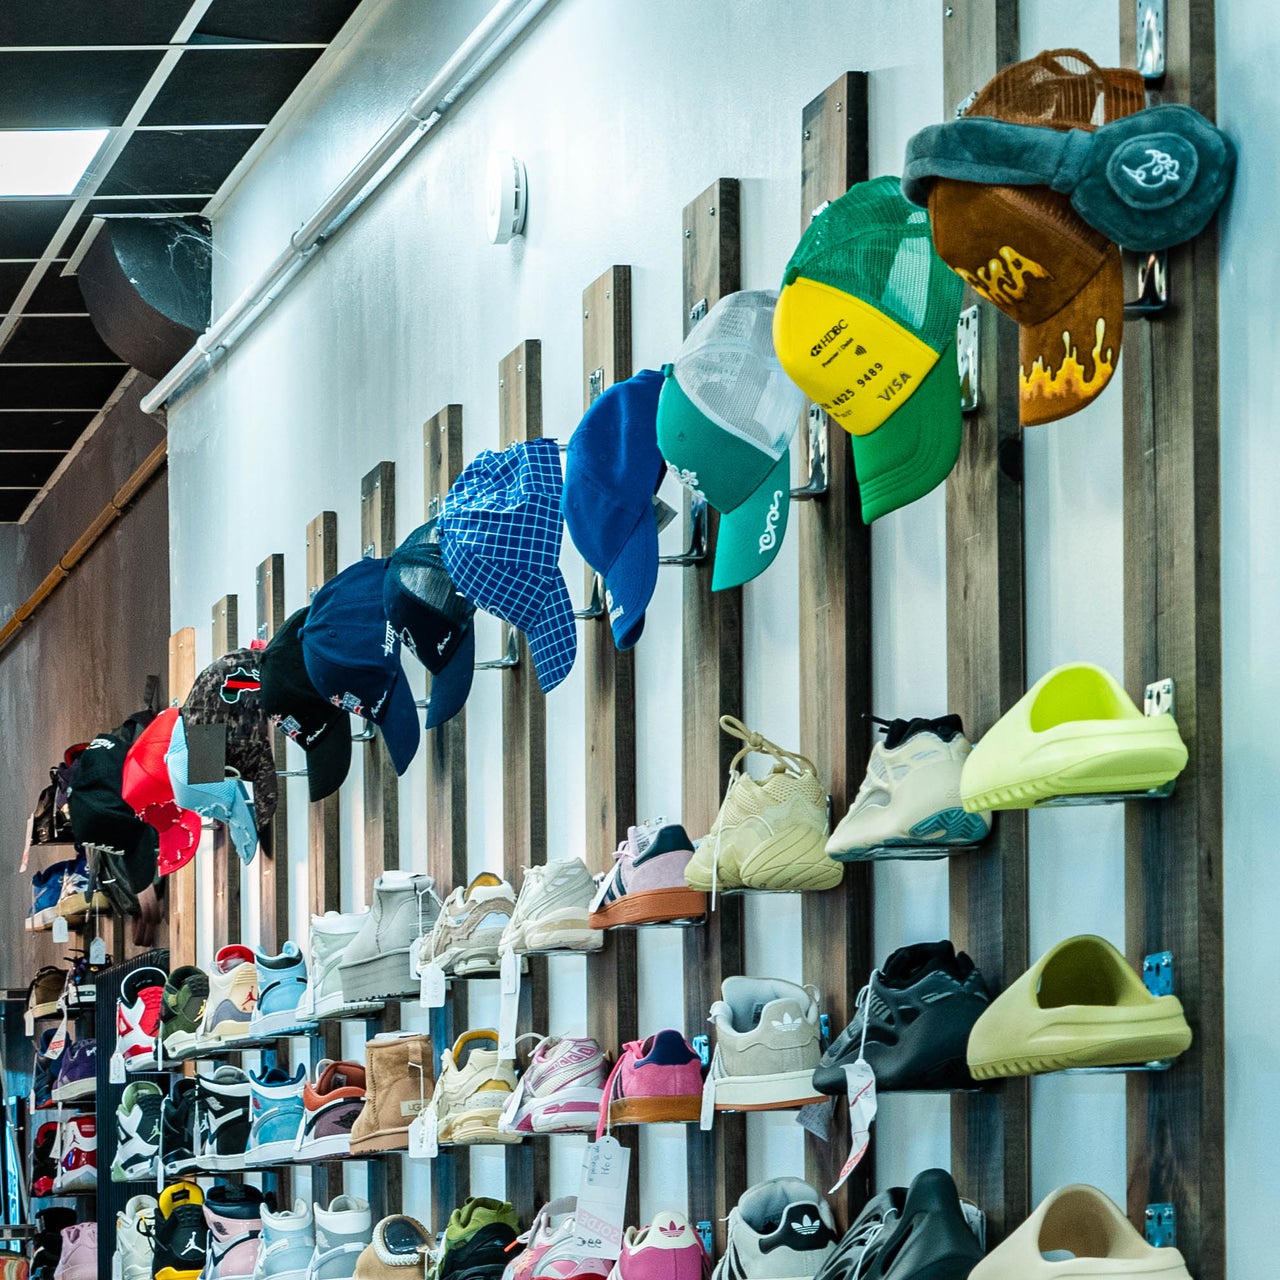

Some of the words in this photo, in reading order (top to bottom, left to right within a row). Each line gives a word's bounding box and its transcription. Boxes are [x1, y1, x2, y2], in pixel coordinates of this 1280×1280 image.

[821, 319, 848, 347] HDBC
[857, 361, 884, 387] 9489
[876, 371, 912, 402] VISA
